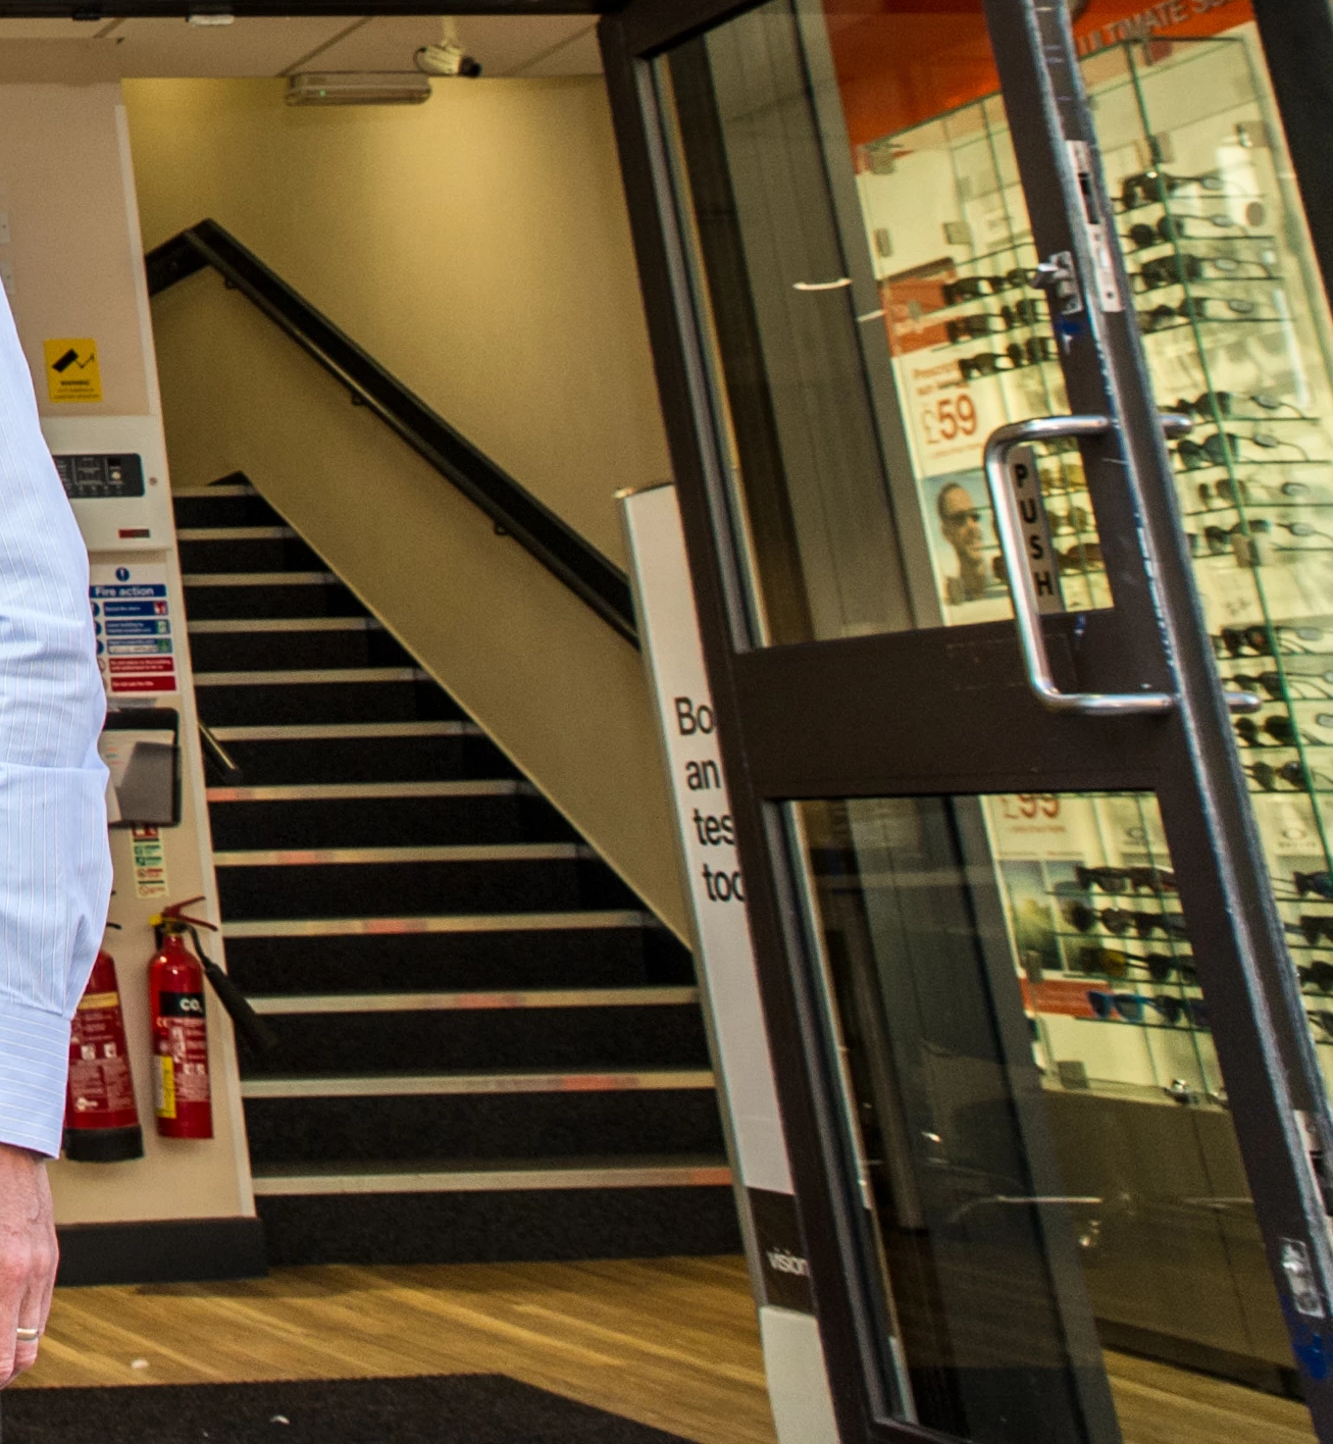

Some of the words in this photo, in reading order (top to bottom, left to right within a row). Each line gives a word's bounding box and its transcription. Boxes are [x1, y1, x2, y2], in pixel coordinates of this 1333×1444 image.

[1014, 463, 1054, 596] PUSH
[95, 586, 116, 597] Fire
[119, 585, 155, 596] action
[685, 759, 721, 791] an
